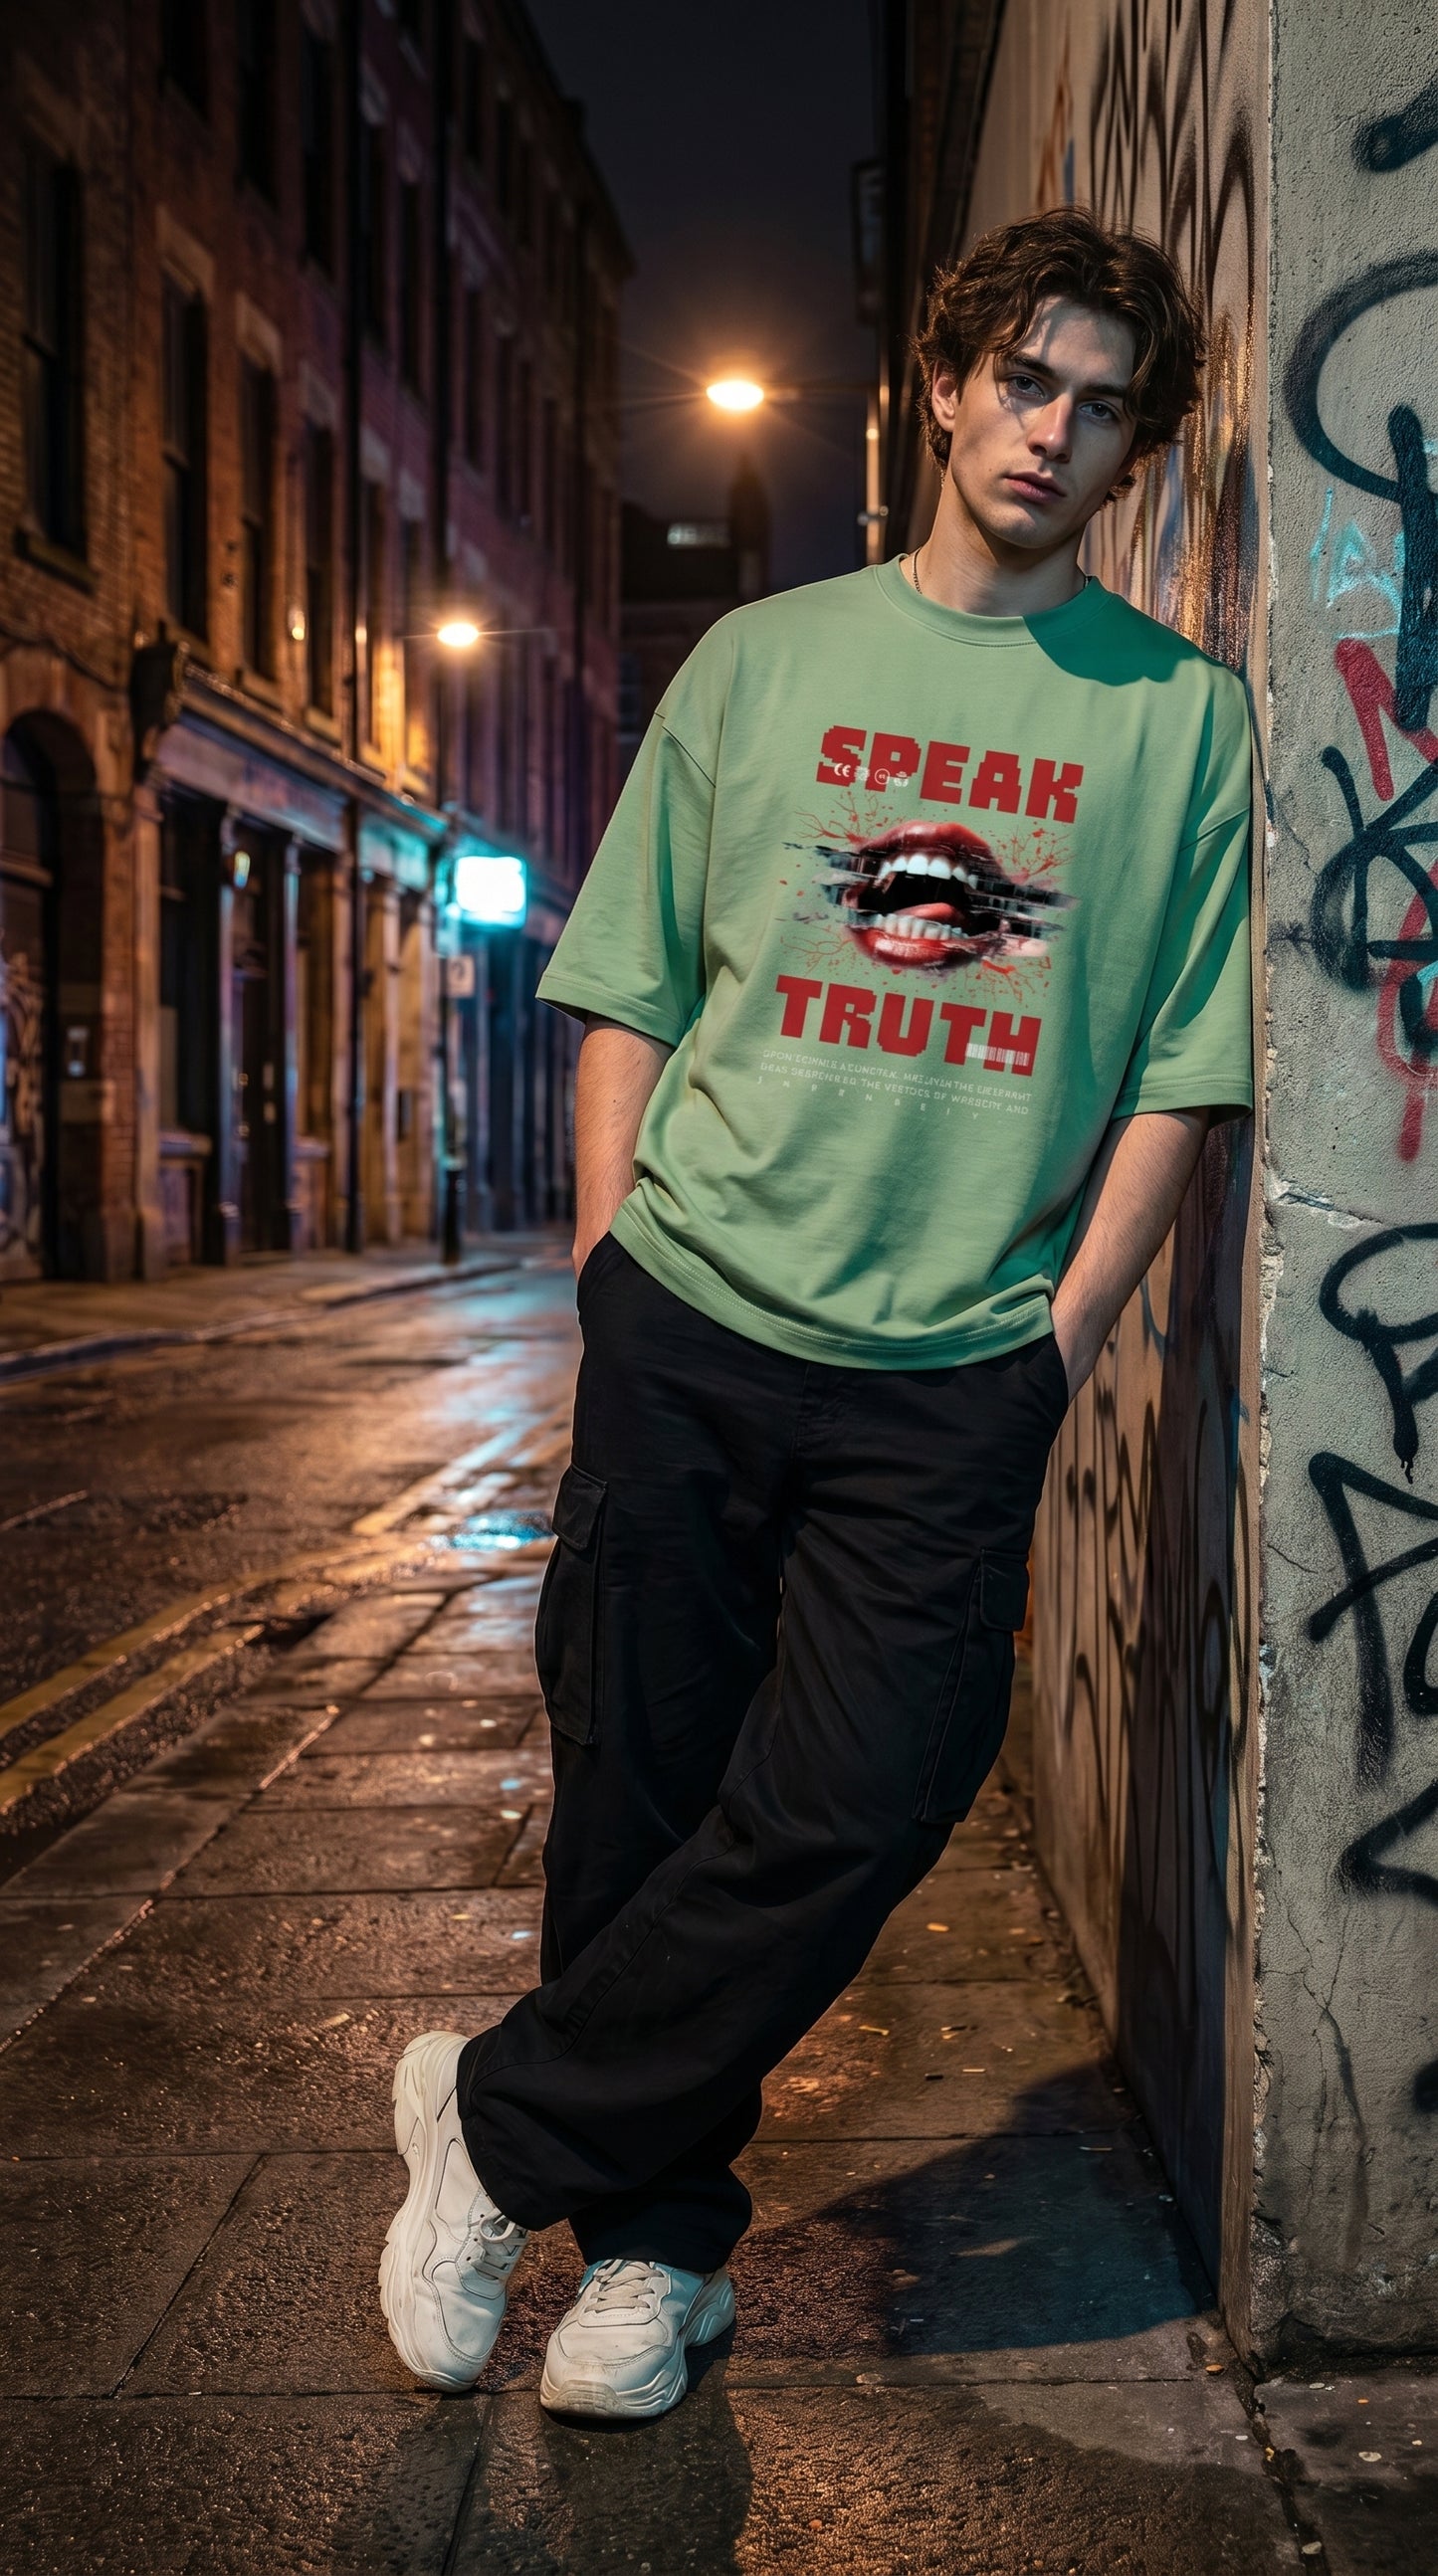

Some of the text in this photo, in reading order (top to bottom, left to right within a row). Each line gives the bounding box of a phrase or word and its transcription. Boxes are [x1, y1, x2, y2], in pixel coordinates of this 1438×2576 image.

[816, 724, 1084, 824] SPEAK
[776, 974, 1042, 1077] TRUTH
[860, 1079, 882, 1090] THE
[1005, 1103, 1029, 1115] AND
[953, 1081, 974, 1092] THE
